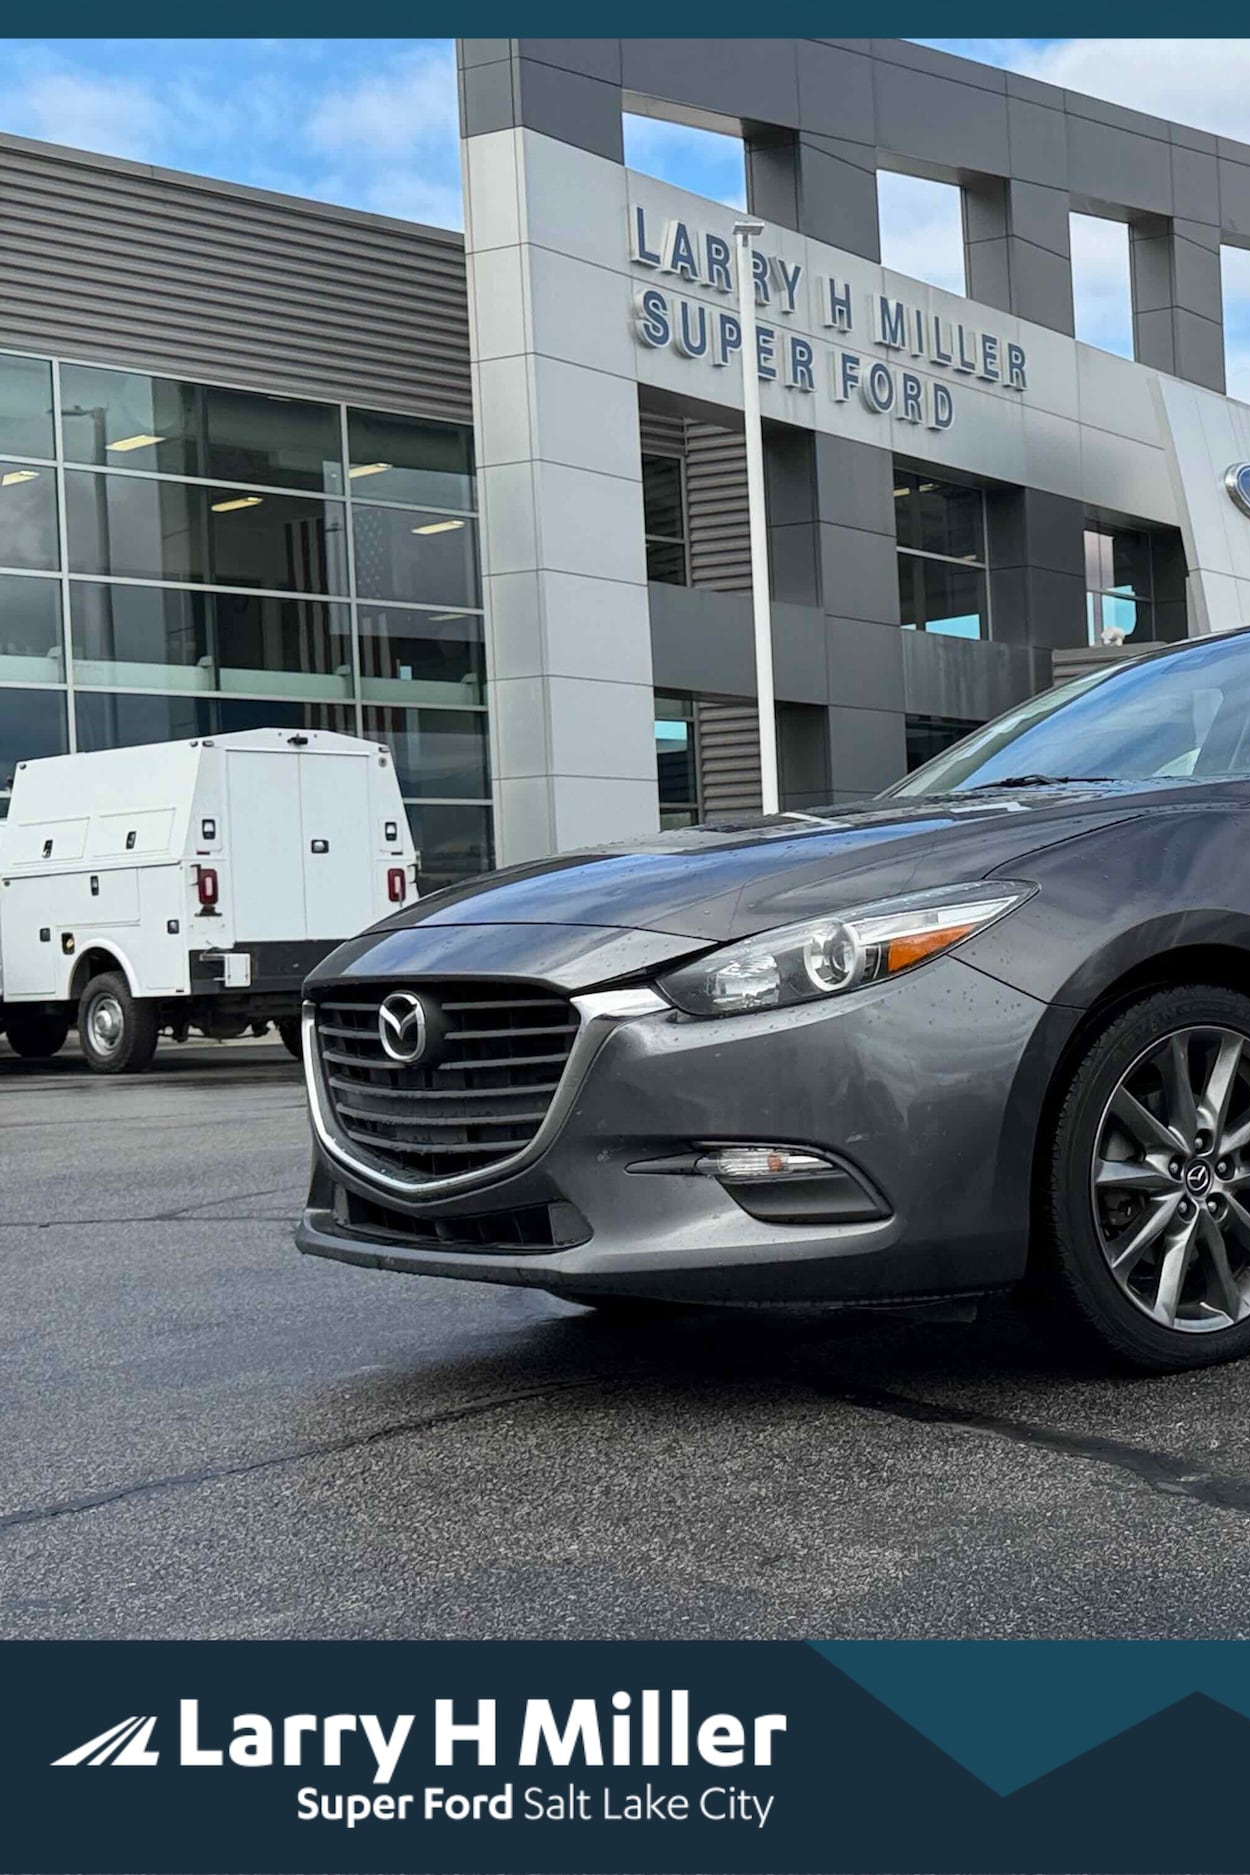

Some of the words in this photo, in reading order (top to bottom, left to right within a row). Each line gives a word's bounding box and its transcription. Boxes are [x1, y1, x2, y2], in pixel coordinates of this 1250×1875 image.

[632, 205, 803, 313] LARRY
[826, 277, 852, 331] H
[875, 294, 1028, 391] MILLER
[637, 289, 816, 392] SUPER
[838, 351, 954, 430] FORD
